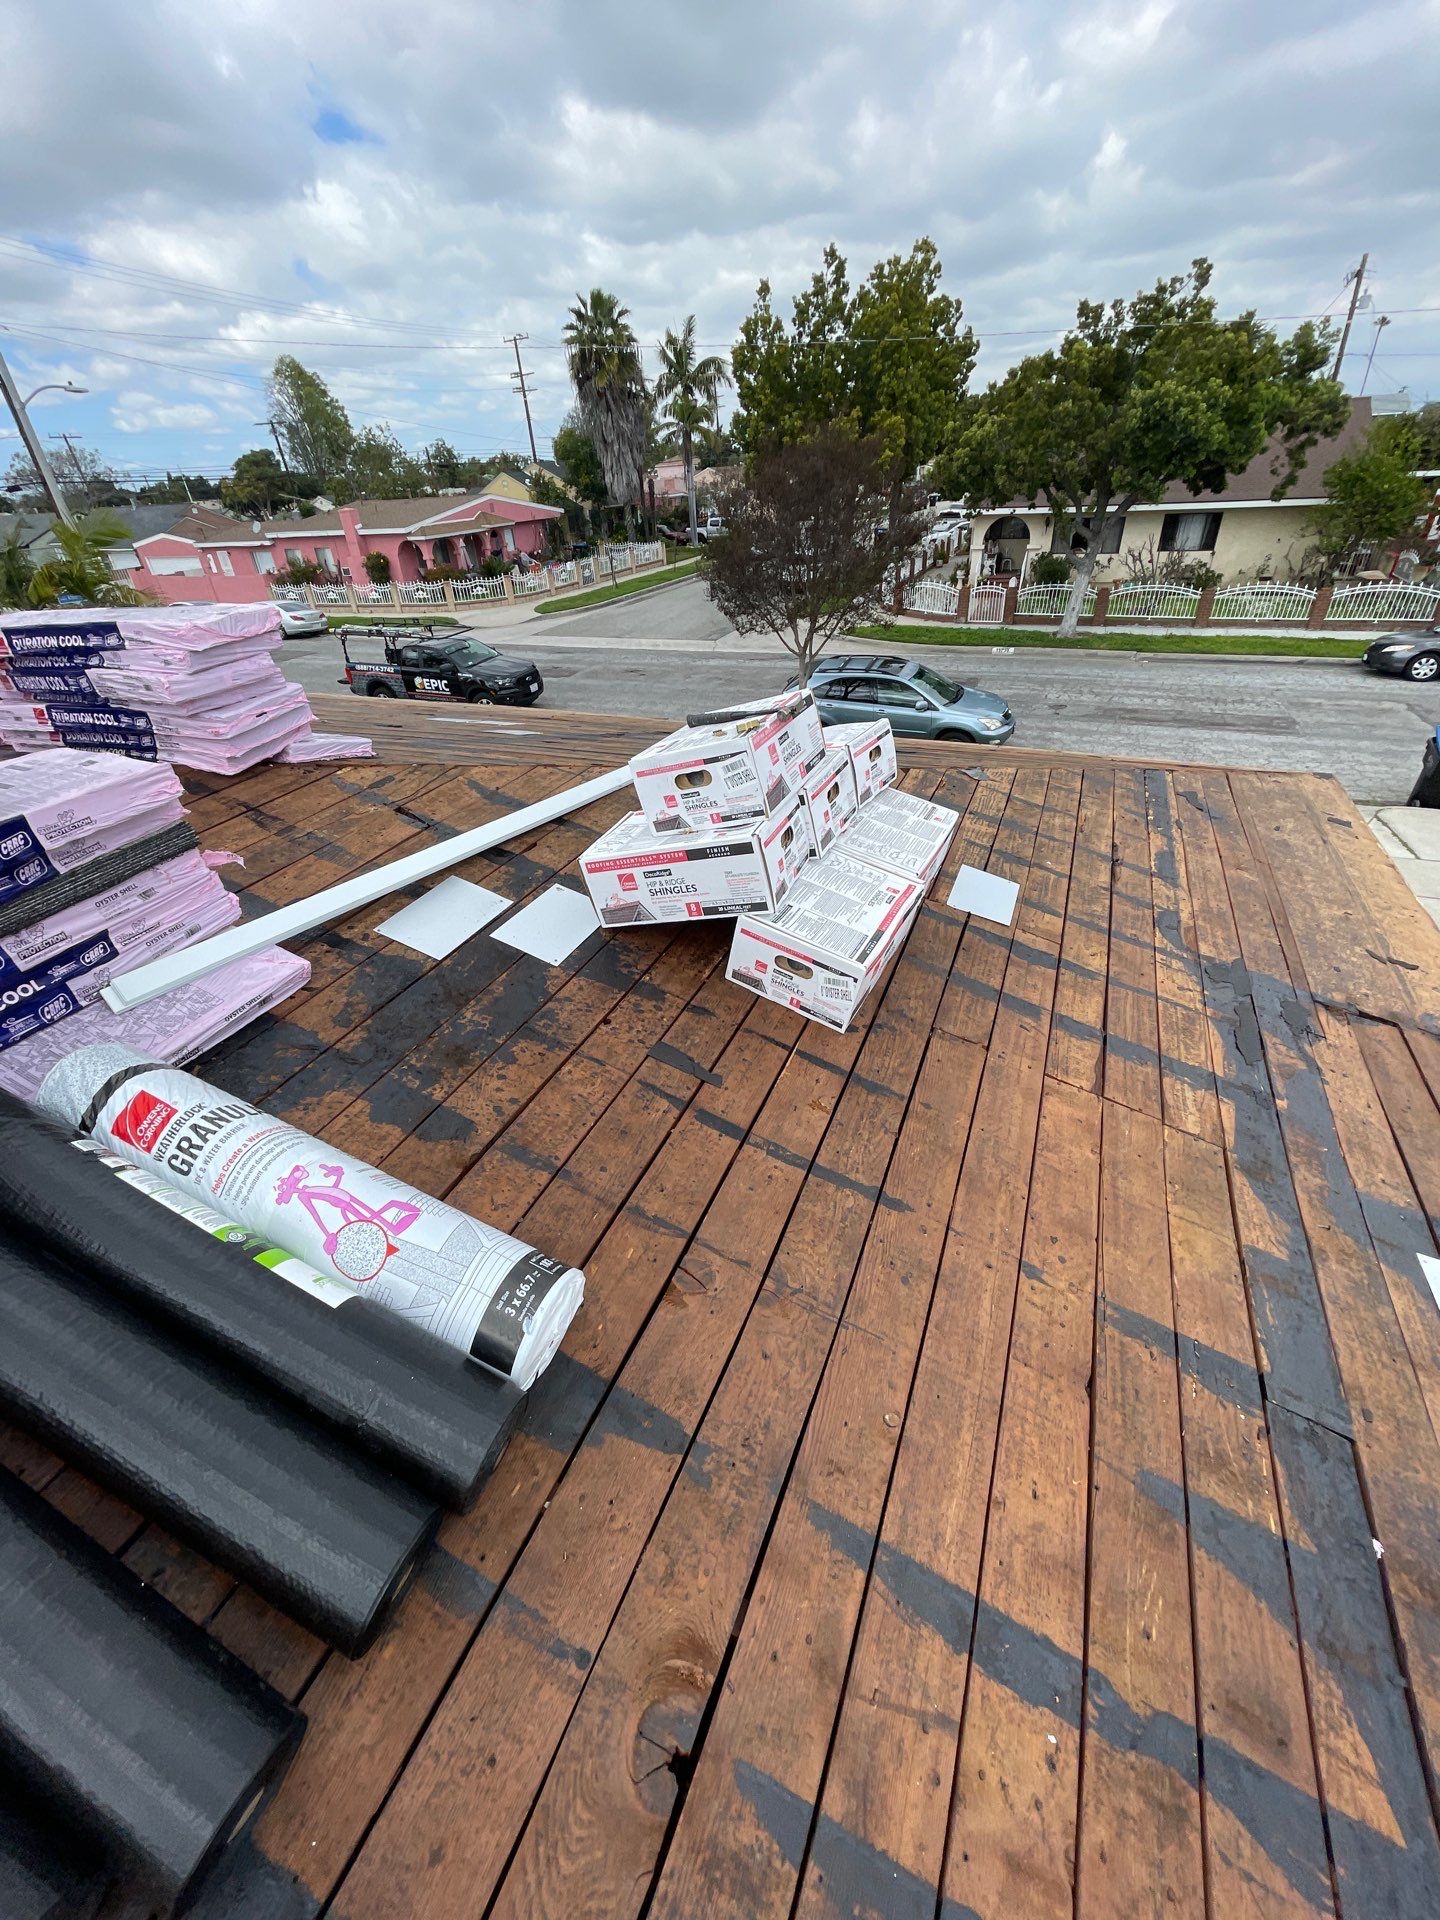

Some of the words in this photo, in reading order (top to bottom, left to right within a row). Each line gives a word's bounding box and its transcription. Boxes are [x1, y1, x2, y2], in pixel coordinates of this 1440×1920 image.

[12, 635, 58, 650] DURATION
[59, 635, 85, 647] COOL
[423, 678, 450, 691] EPIC
[52, 711, 93, 724] DURATION
[93, 714, 119, 726] COOL
[66, 732, 104, 742] DURATION
[104, 733, 126, 743] COOL
[783, 743, 801, 765] SHINGLES
[685, 801, 718, 812] SHINGLES
[45, 817, 92, 840] PROTECTION
[0, 834, 25, 855] CRRC
[60, 842, 102, 866] PROTECTION
[706, 846, 730, 854] FINISH
[659, 852, 684, 860] SYSTEM
[20, 860, 41, 881] CRRC
[648, 884, 698, 897] SHINGLES
[665, 877, 686, 887] RIDGE
[94, 893, 119, 908] OYSTER
[119, 883, 139, 899] SHELL
[690, 903, 697, 912] 8
[145, 931, 169, 947] OYSTER
[168, 922, 185, 936] SHELL
[17, 931, 68, 960] PROTECTION
[84, 944, 104, 963] CRRC
[82, 984, 98, 995] TOTAL
[771, 978, 805, 997] SHINGLES
[44, 996, 66, 1020] CRRC
[224, 1005, 247, 1022] OYSTER
[137, 1103, 165, 1136] OWENS
[140, 1107, 171, 1148] CORNING
[199, 1166, 207, 1174] &
[203, 1143, 222, 1166] WATER
[219, 1123, 248, 1144] BARRIER
[240, 1146, 264, 1171] secondary
[262, 1148, 287, 1172] granulated
[211, 1172, 227, 1195] Helps
[222, 1148, 243, 1172] Create
[233, 1184, 244, 1202] Helps
[243, 1164, 256, 1186] prevent
[255, 1147, 276, 1165] damage
[516, 1274, 536, 1298] 66.7
[496, 1301, 504, 1311] Roll
[502, 1290, 511, 1302] Size
[511, 1297, 522, 1308] x
[504, 1306, 516, 1317] 3
